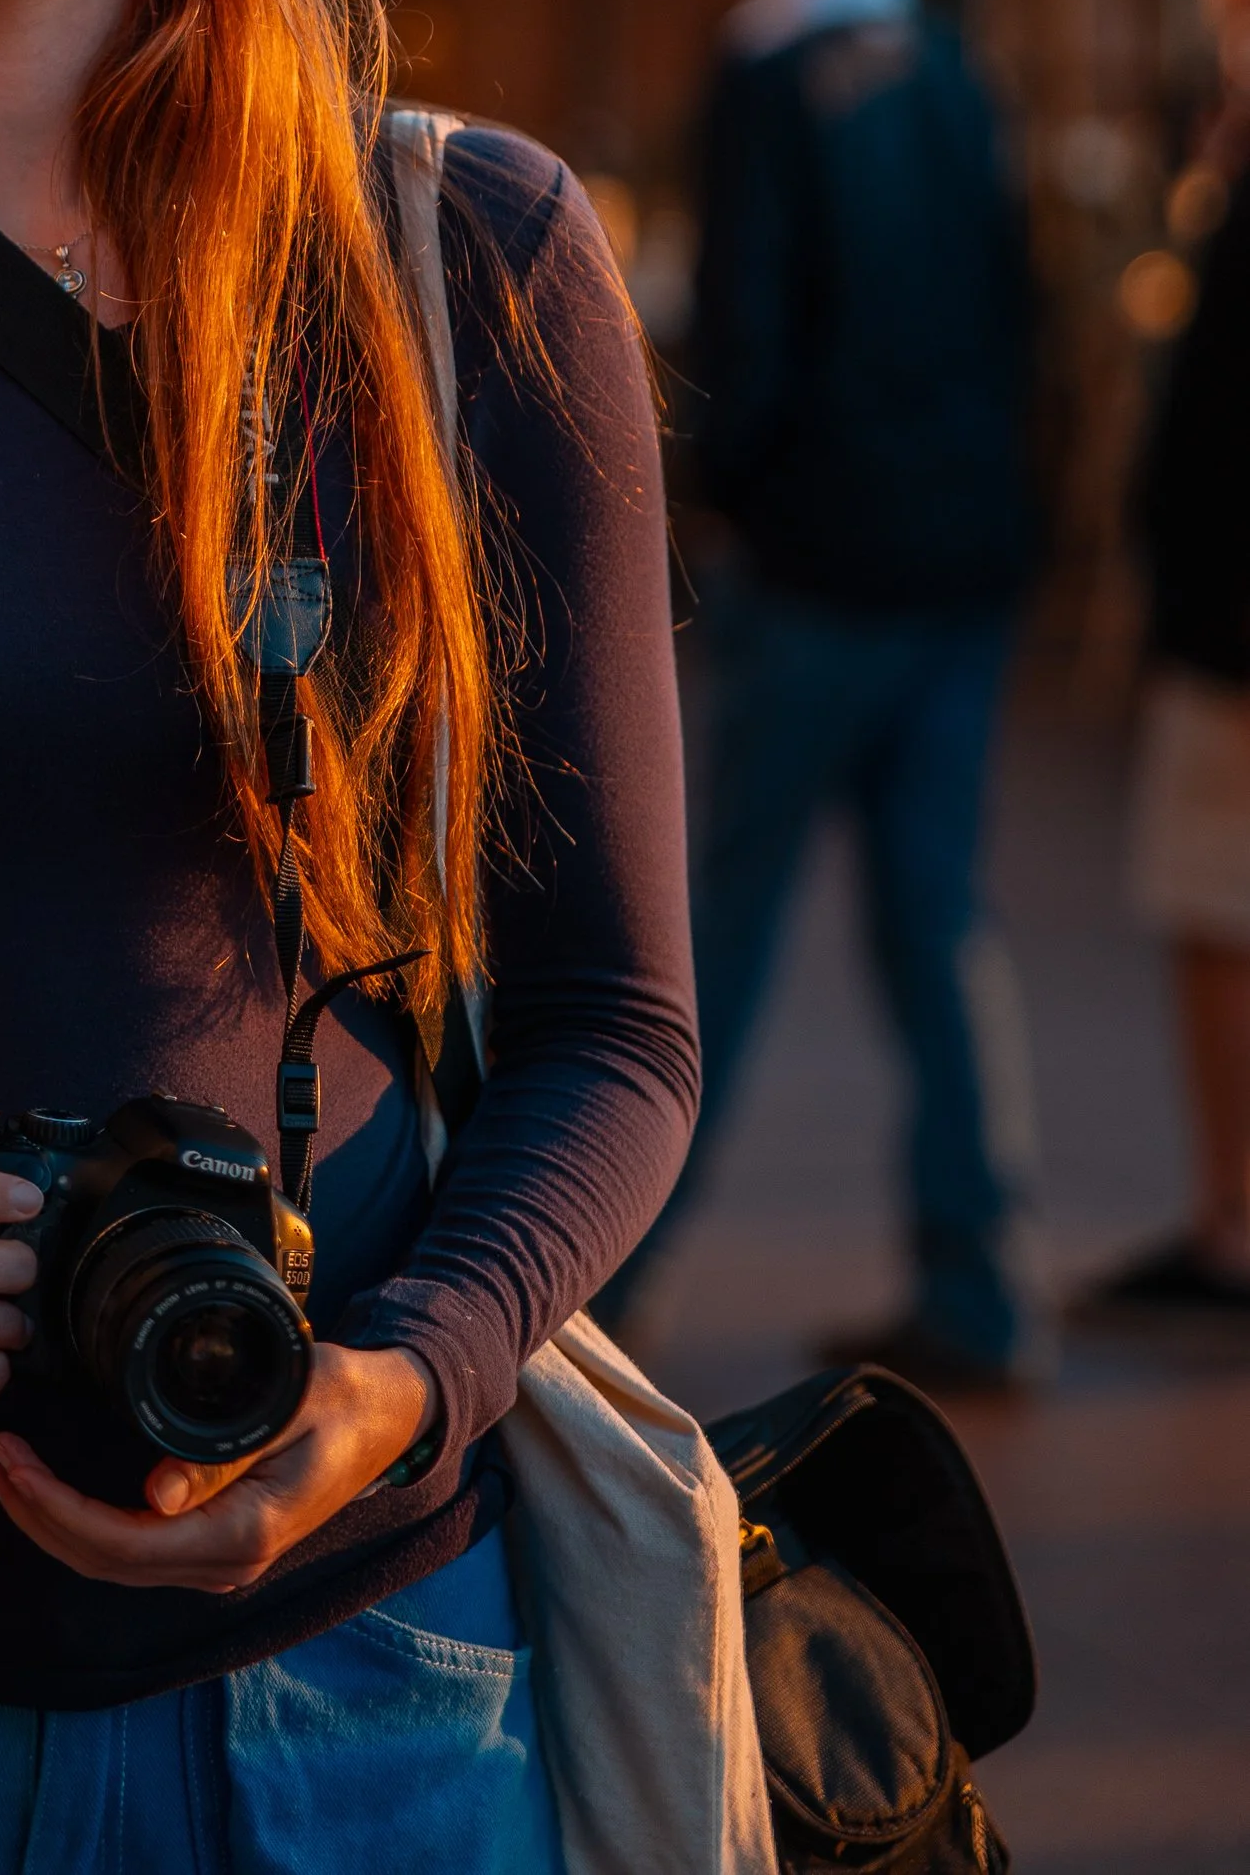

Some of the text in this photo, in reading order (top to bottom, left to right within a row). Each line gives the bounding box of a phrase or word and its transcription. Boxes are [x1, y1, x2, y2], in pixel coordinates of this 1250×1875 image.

[182, 1150, 256, 1182] Canon
[288, 1252, 310, 1267] EOS
[285, 1270, 311, 1286] 550D
